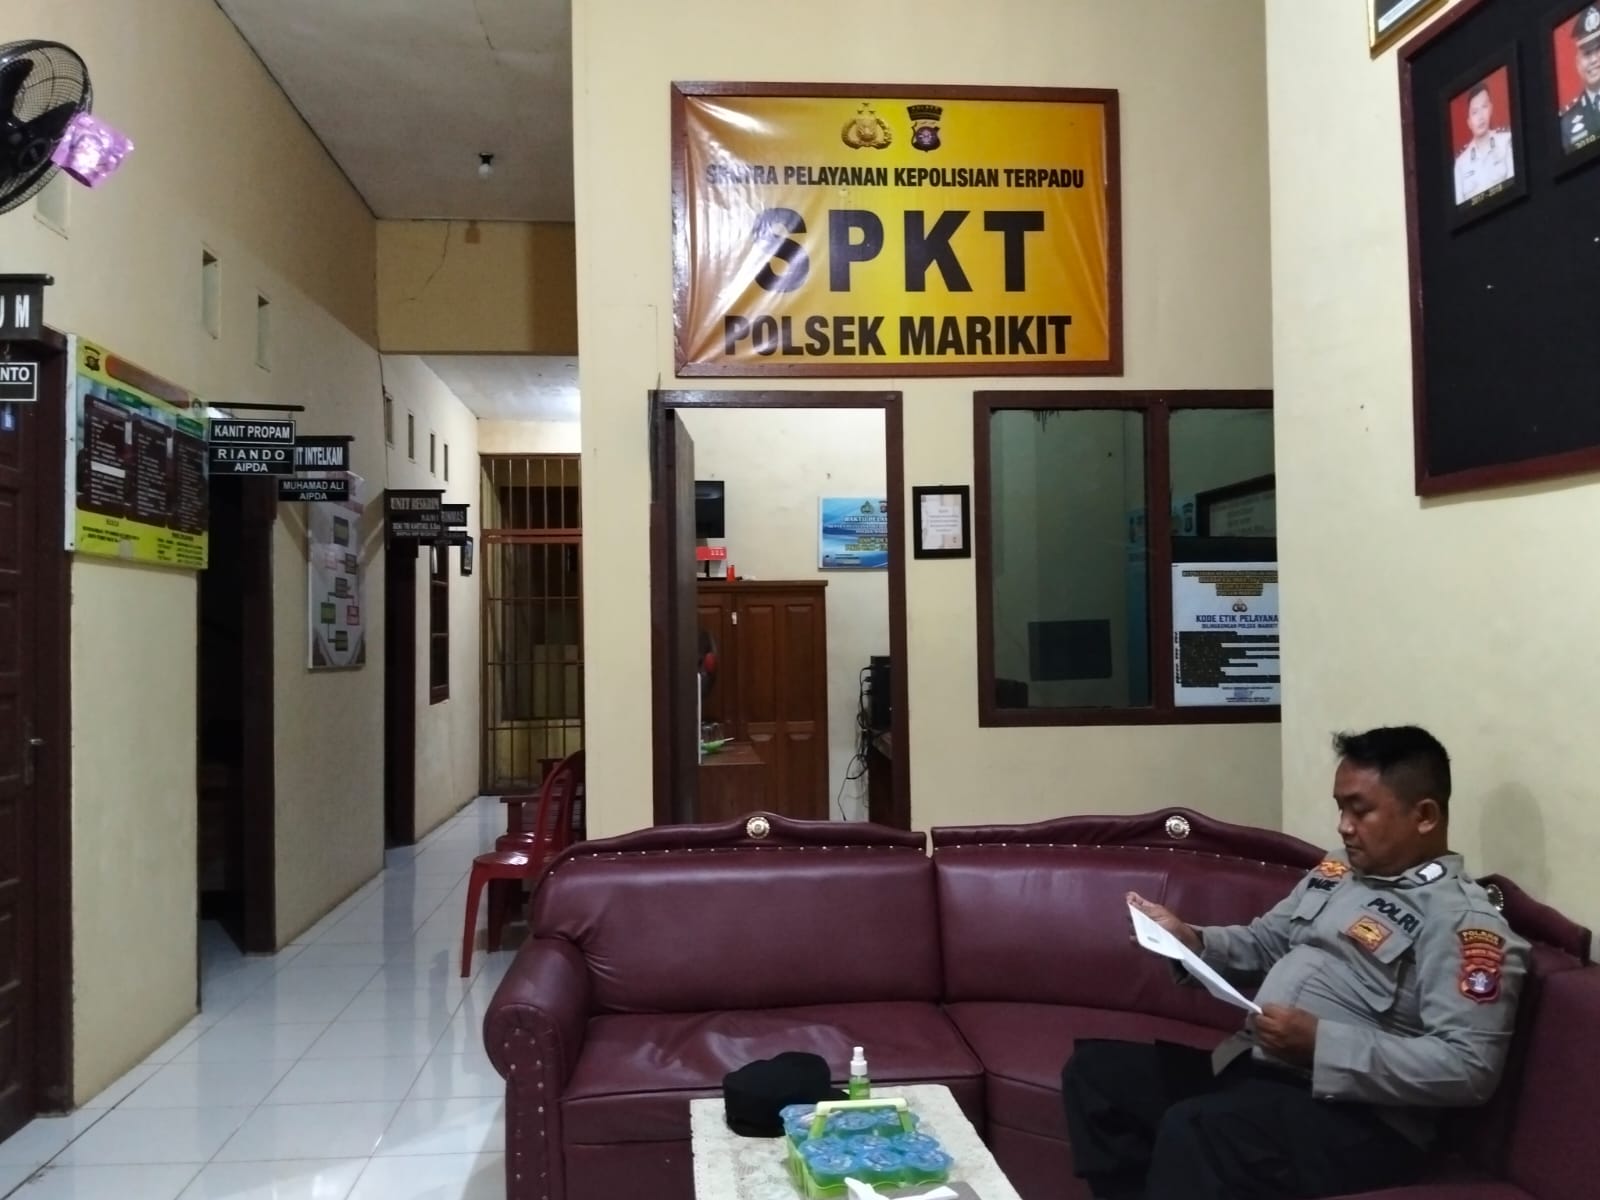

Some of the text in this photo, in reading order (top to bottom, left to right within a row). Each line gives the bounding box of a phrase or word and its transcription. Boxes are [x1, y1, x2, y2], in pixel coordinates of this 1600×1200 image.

[784, 167, 888, 186] PELAYANAN
[895, 167, 998, 188] KEPOLISIAN
[1004, 168, 1085, 188] TERPADU
[753, 207, 1045, 293] SPKT
[724, 315, 1072, 356] POLSEK MARIKIT
[214, 424, 246, 438] KANIT
[248, 426, 290, 440] PROPAM
[218, 449, 286, 460] RIANDO
[305, 446, 344, 466] INTELKAM
[234, 463, 268, 472] AIPDA
[283, 481, 345, 490] MUHAMAD ALI
[299, 492, 328, 500] AIPDA
[1196, 614, 1216, 622] KODE
[1218, 614, 1238, 622] ETIK
[1367, 897, 1420, 934] POLRI
